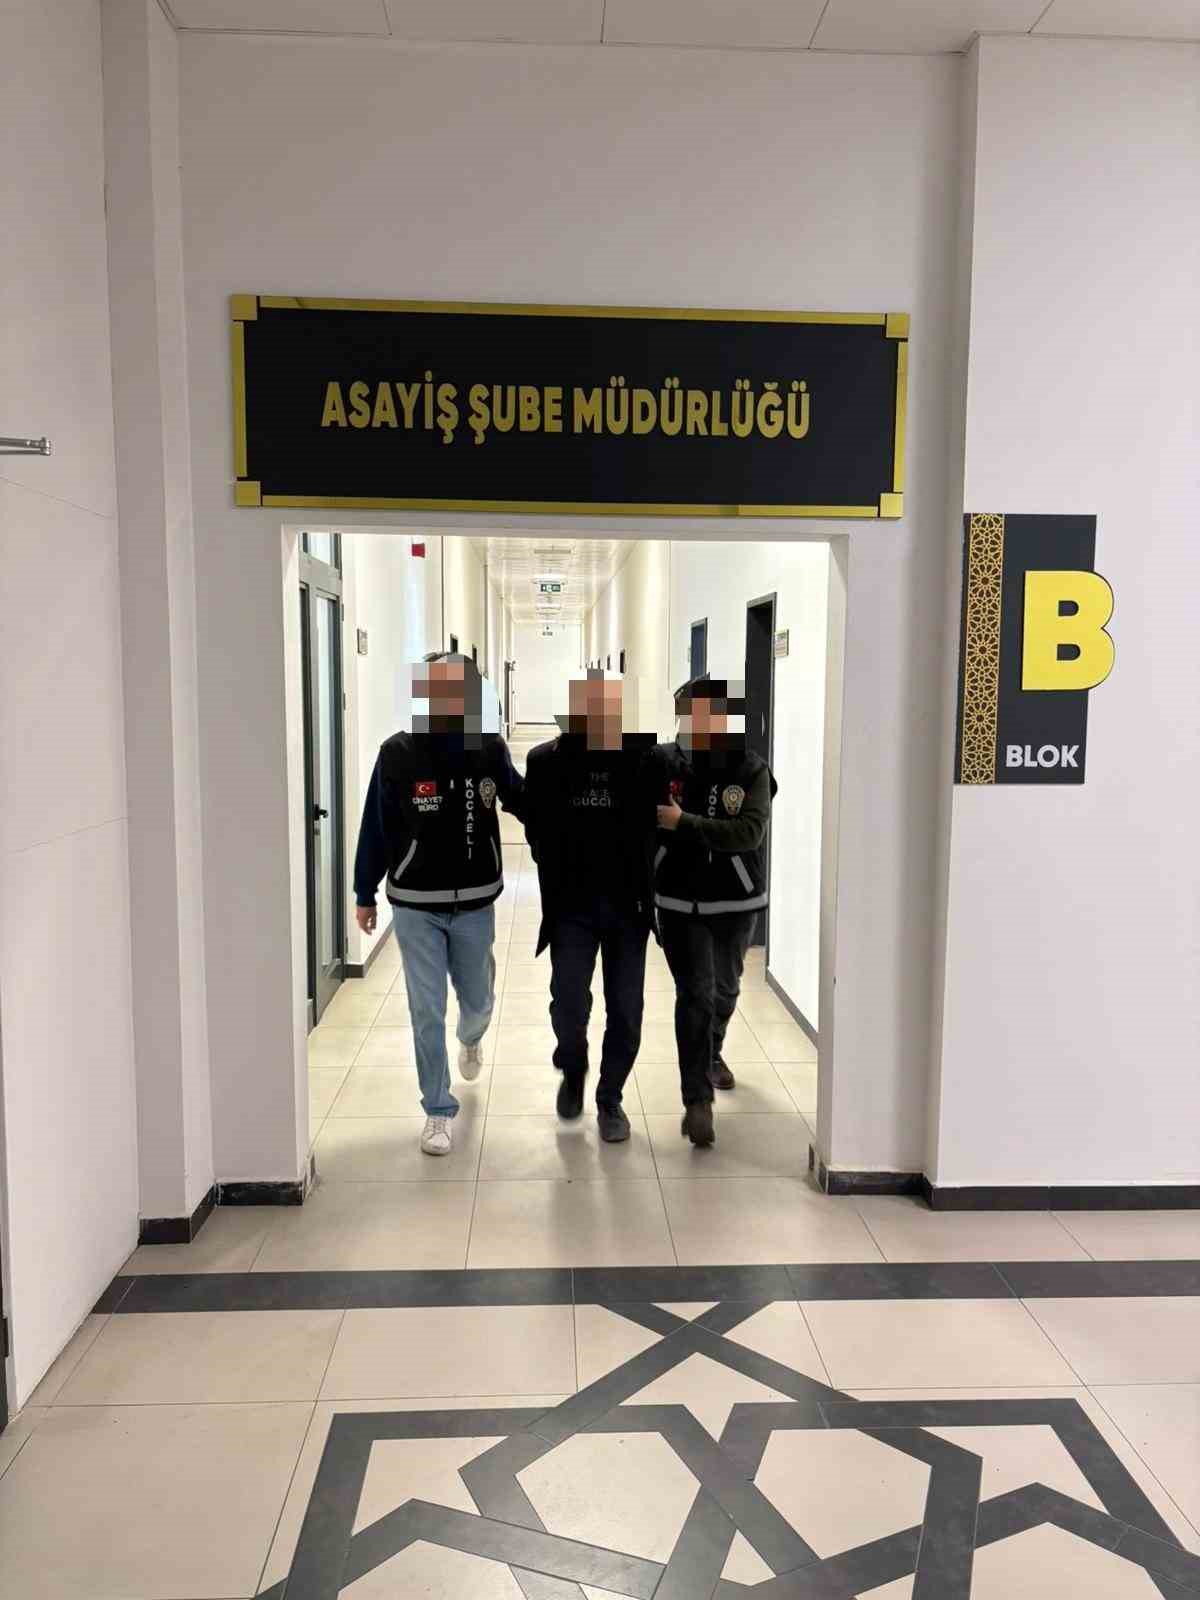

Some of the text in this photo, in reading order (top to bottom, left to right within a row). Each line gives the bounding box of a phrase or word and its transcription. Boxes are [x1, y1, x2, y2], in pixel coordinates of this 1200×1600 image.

[321, 370, 811, 445] ASAYİŞ ŞUBE MÜDÜRLÜĞÜ
[1021, 569, 1116, 692] B
[1005, 744, 1080, 768] BLOK
